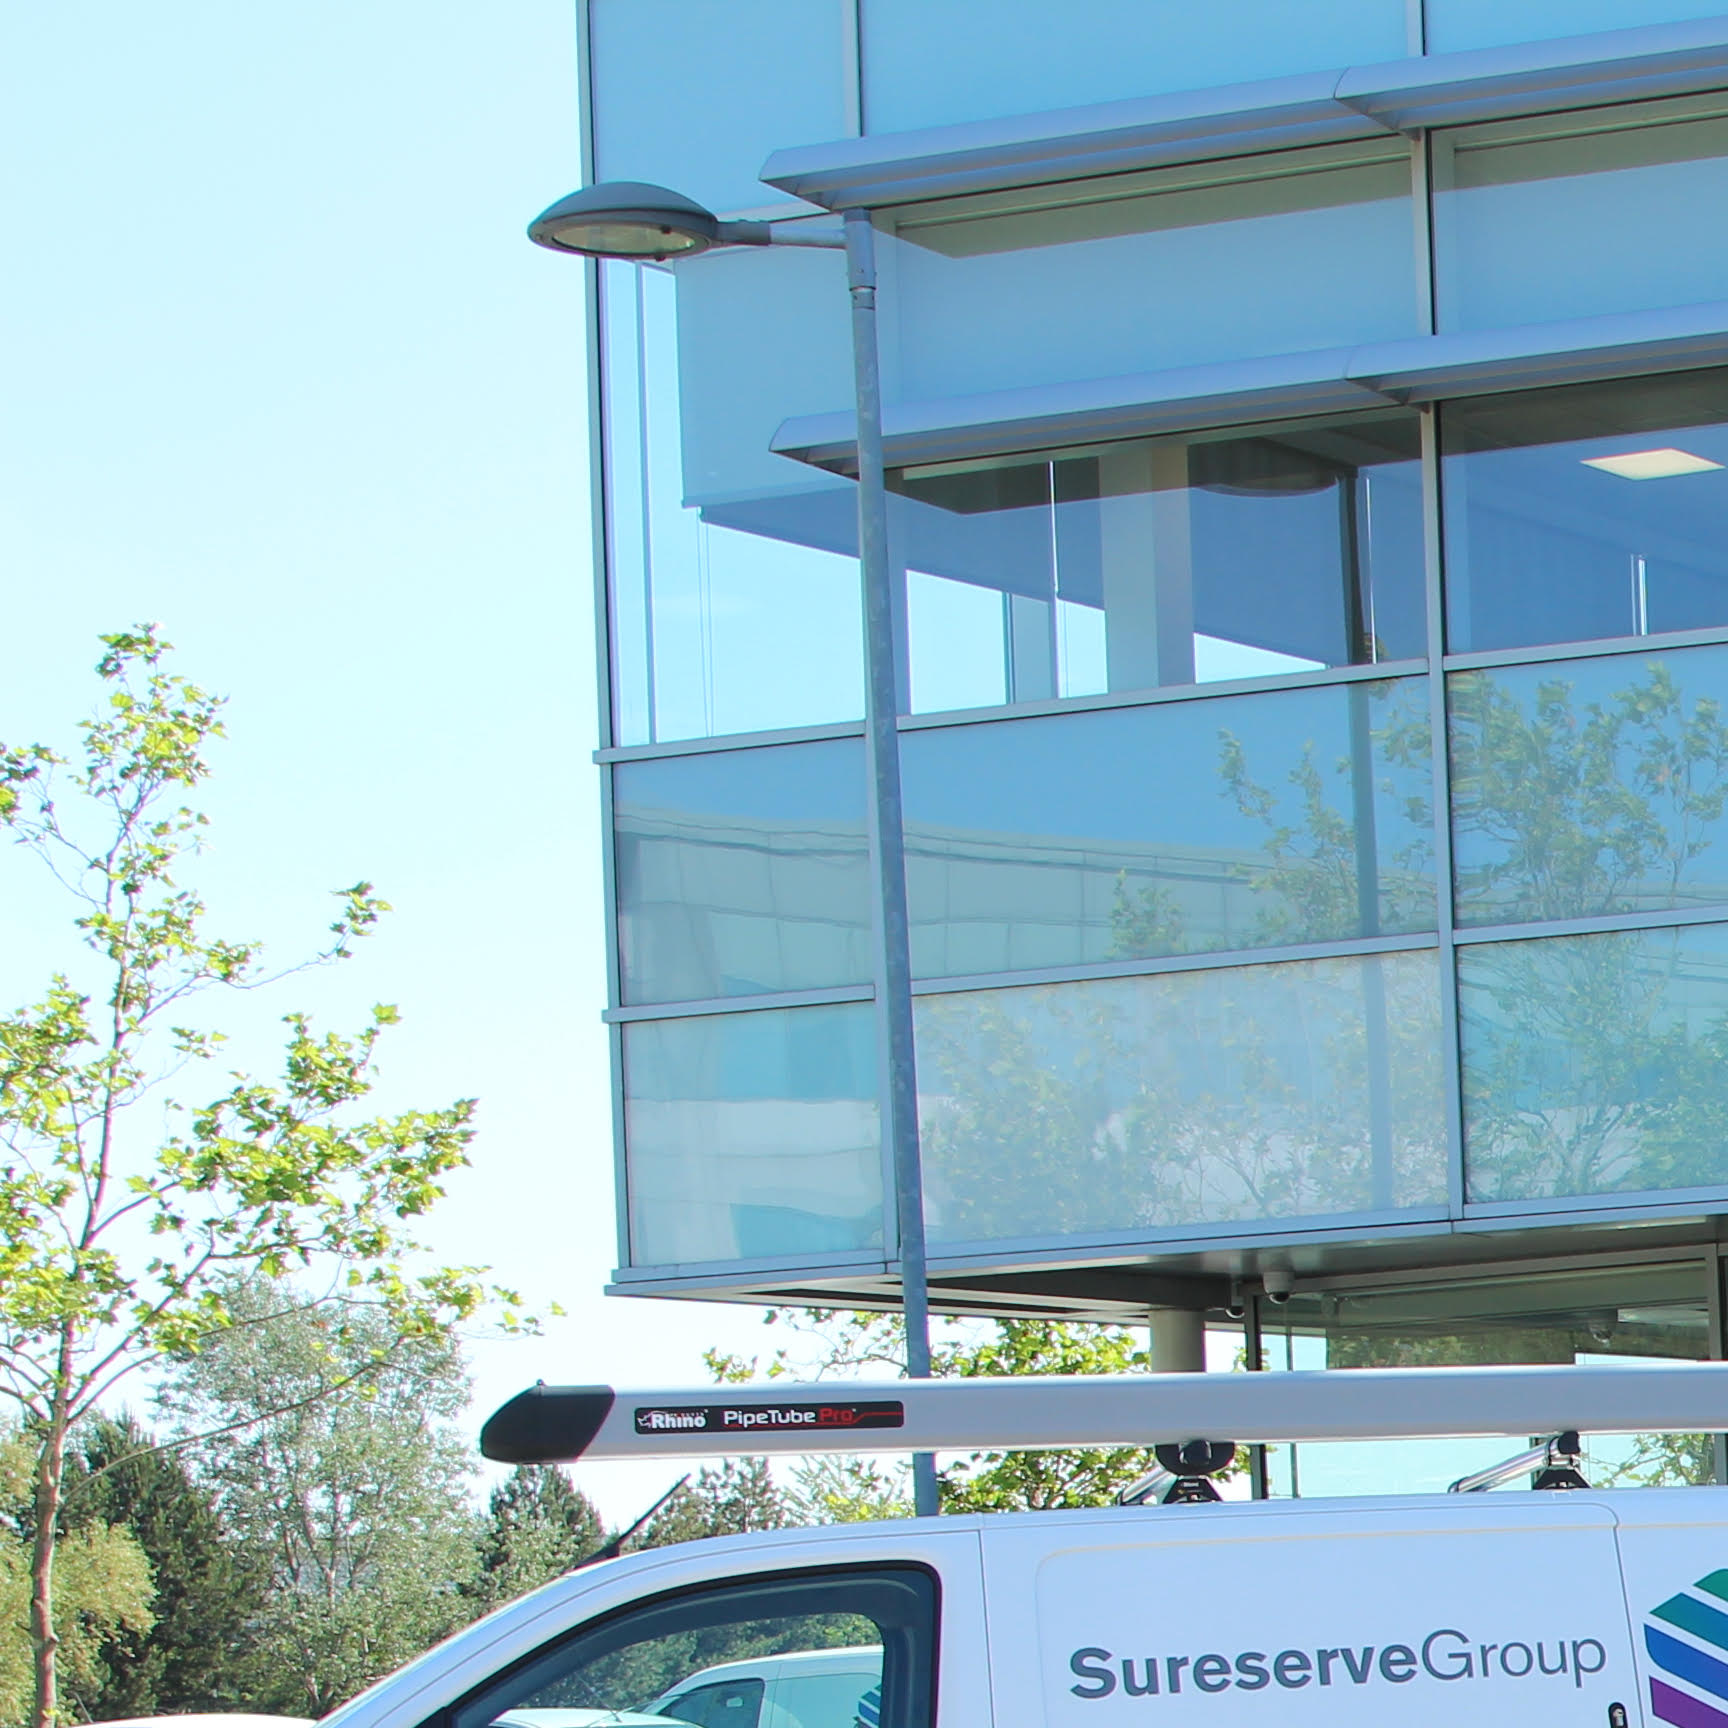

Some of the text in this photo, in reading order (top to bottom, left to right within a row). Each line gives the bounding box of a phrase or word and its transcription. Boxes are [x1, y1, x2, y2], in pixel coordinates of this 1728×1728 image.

[651, 1413, 707, 1428] Rhino
[723, 1407, 853, 1428] PipeTube Pro
[1070, 1629, 1607, 1698] SureserveGroup
